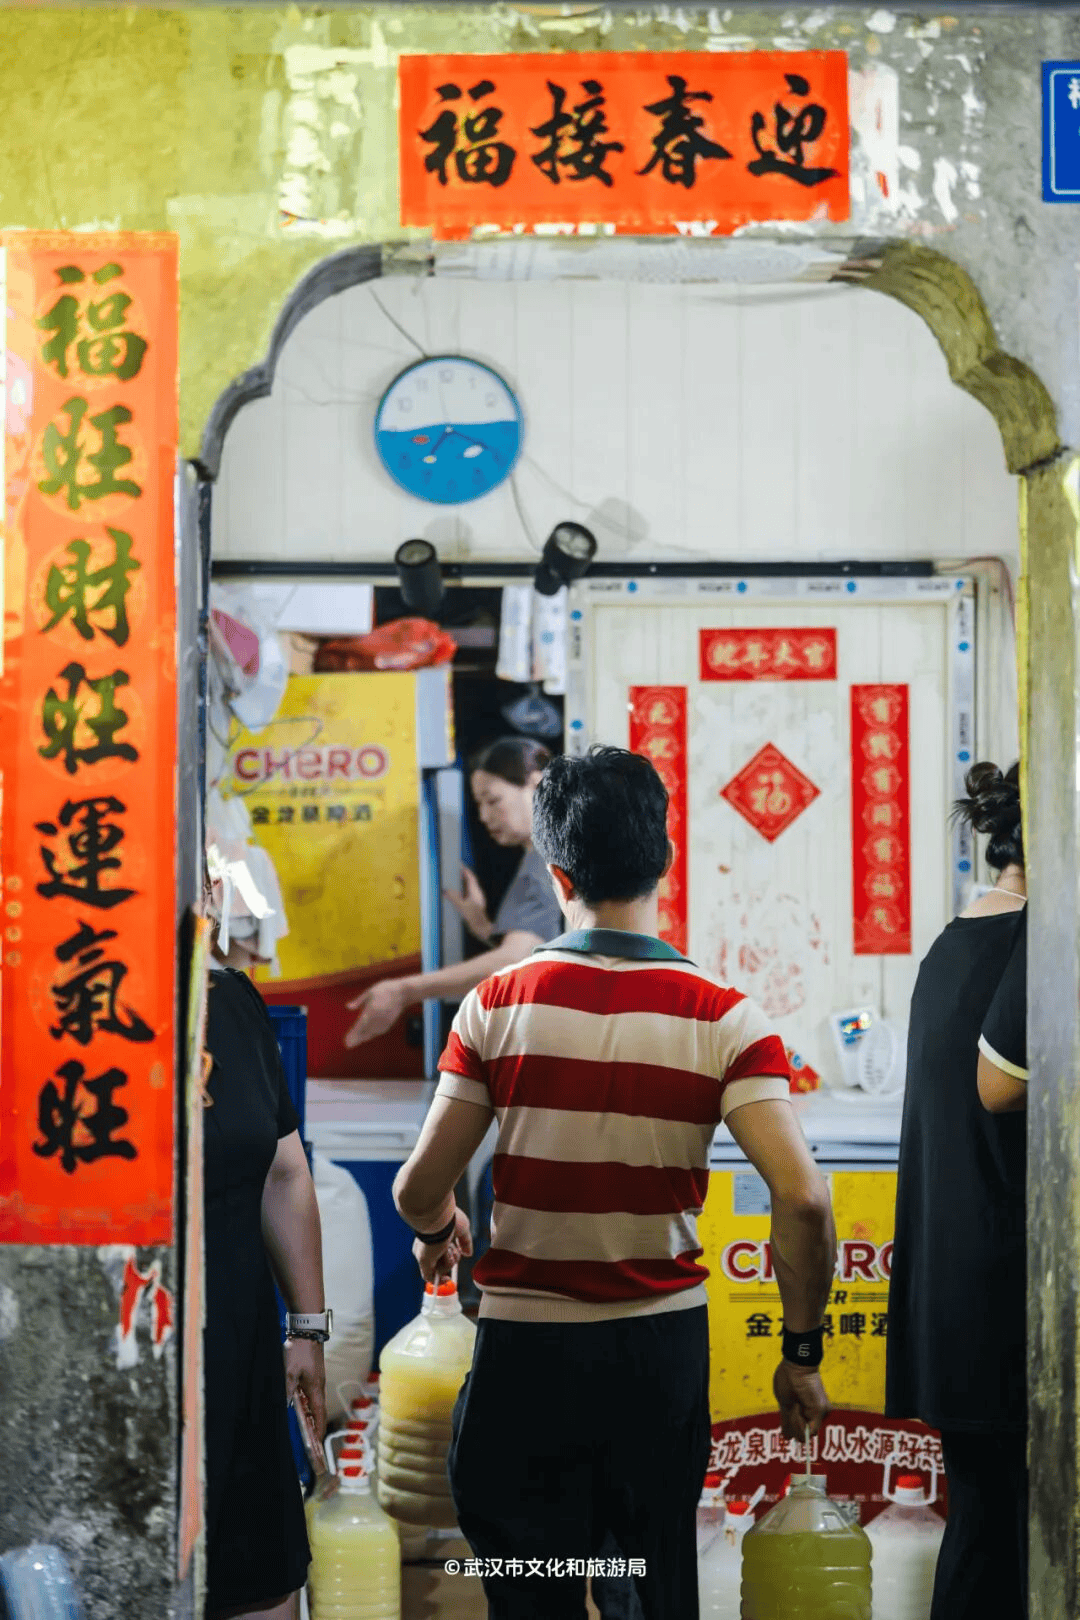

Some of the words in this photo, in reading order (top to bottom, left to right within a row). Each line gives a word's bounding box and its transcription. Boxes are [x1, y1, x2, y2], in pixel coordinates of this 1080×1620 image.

[32, 262, 156, 1175] 福旺財旺運氣旺
